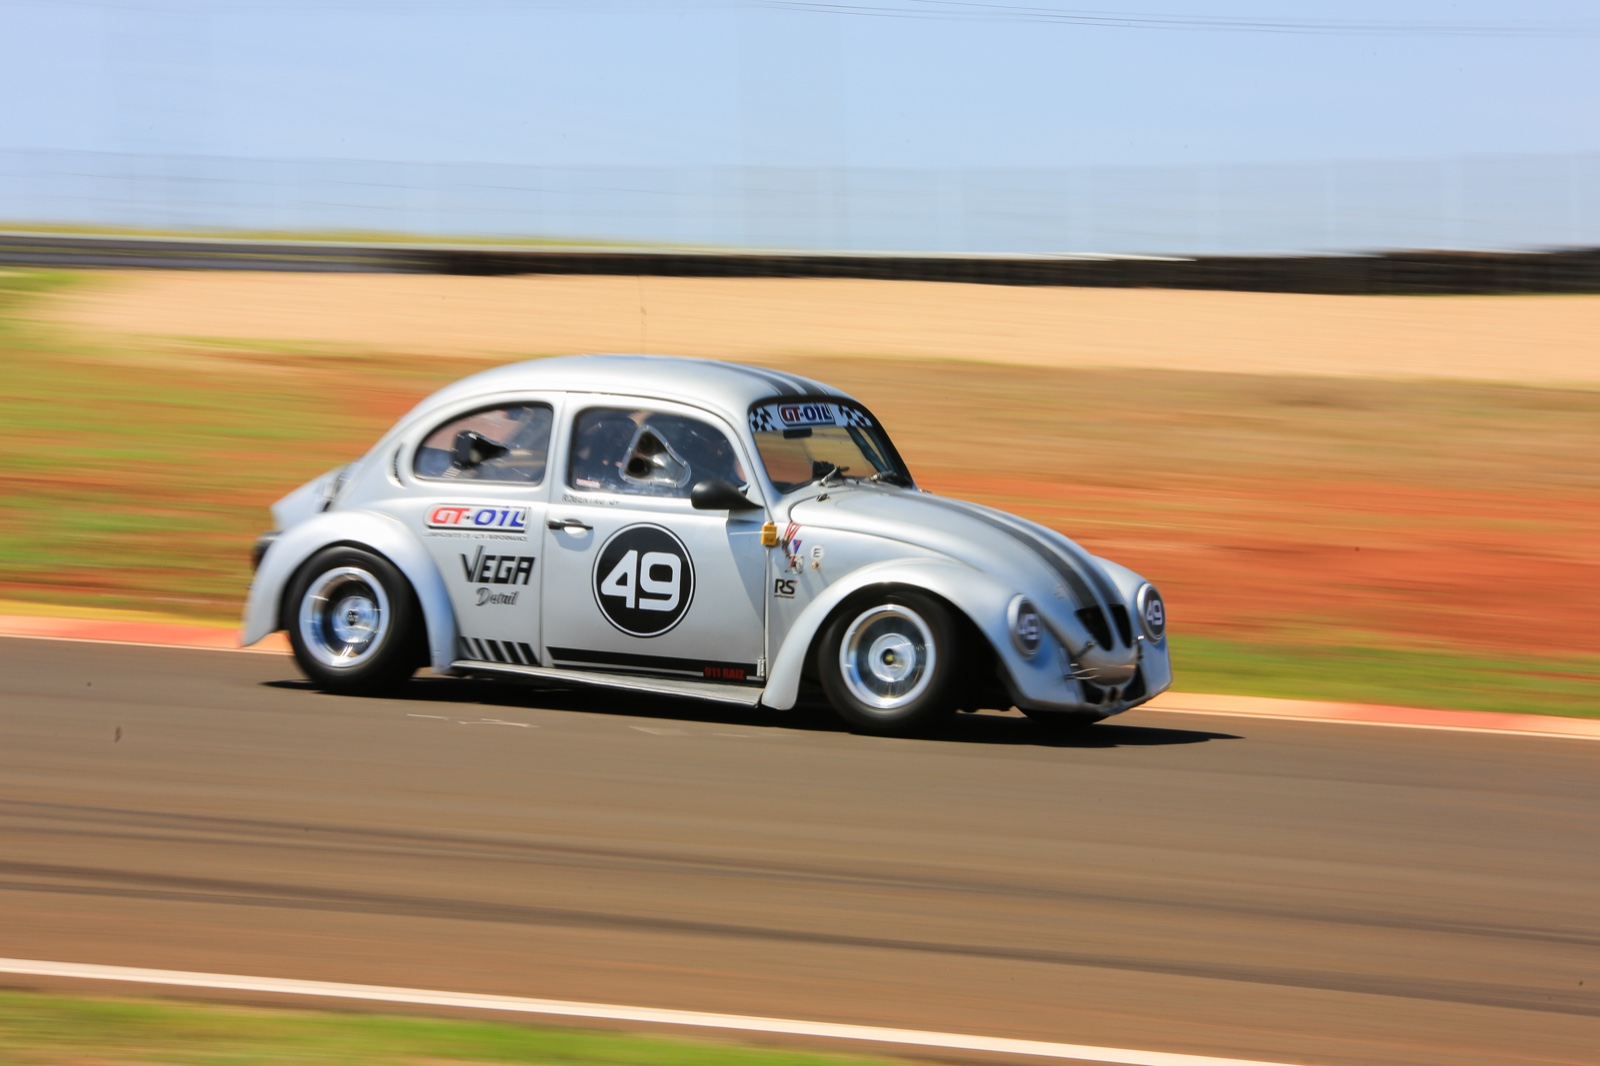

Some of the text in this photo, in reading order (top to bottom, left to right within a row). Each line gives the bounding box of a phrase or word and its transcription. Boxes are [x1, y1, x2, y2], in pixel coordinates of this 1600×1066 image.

[460, 545, 536, 585] VEGA
[600, 549, 682, 612] 49
[774, 578, 797, 595] RS
[1145, 600, 1163, 626] 49
[1018, 613, 1040, 641] 49
[705, 667, 745, 680] 911 RAIZ
